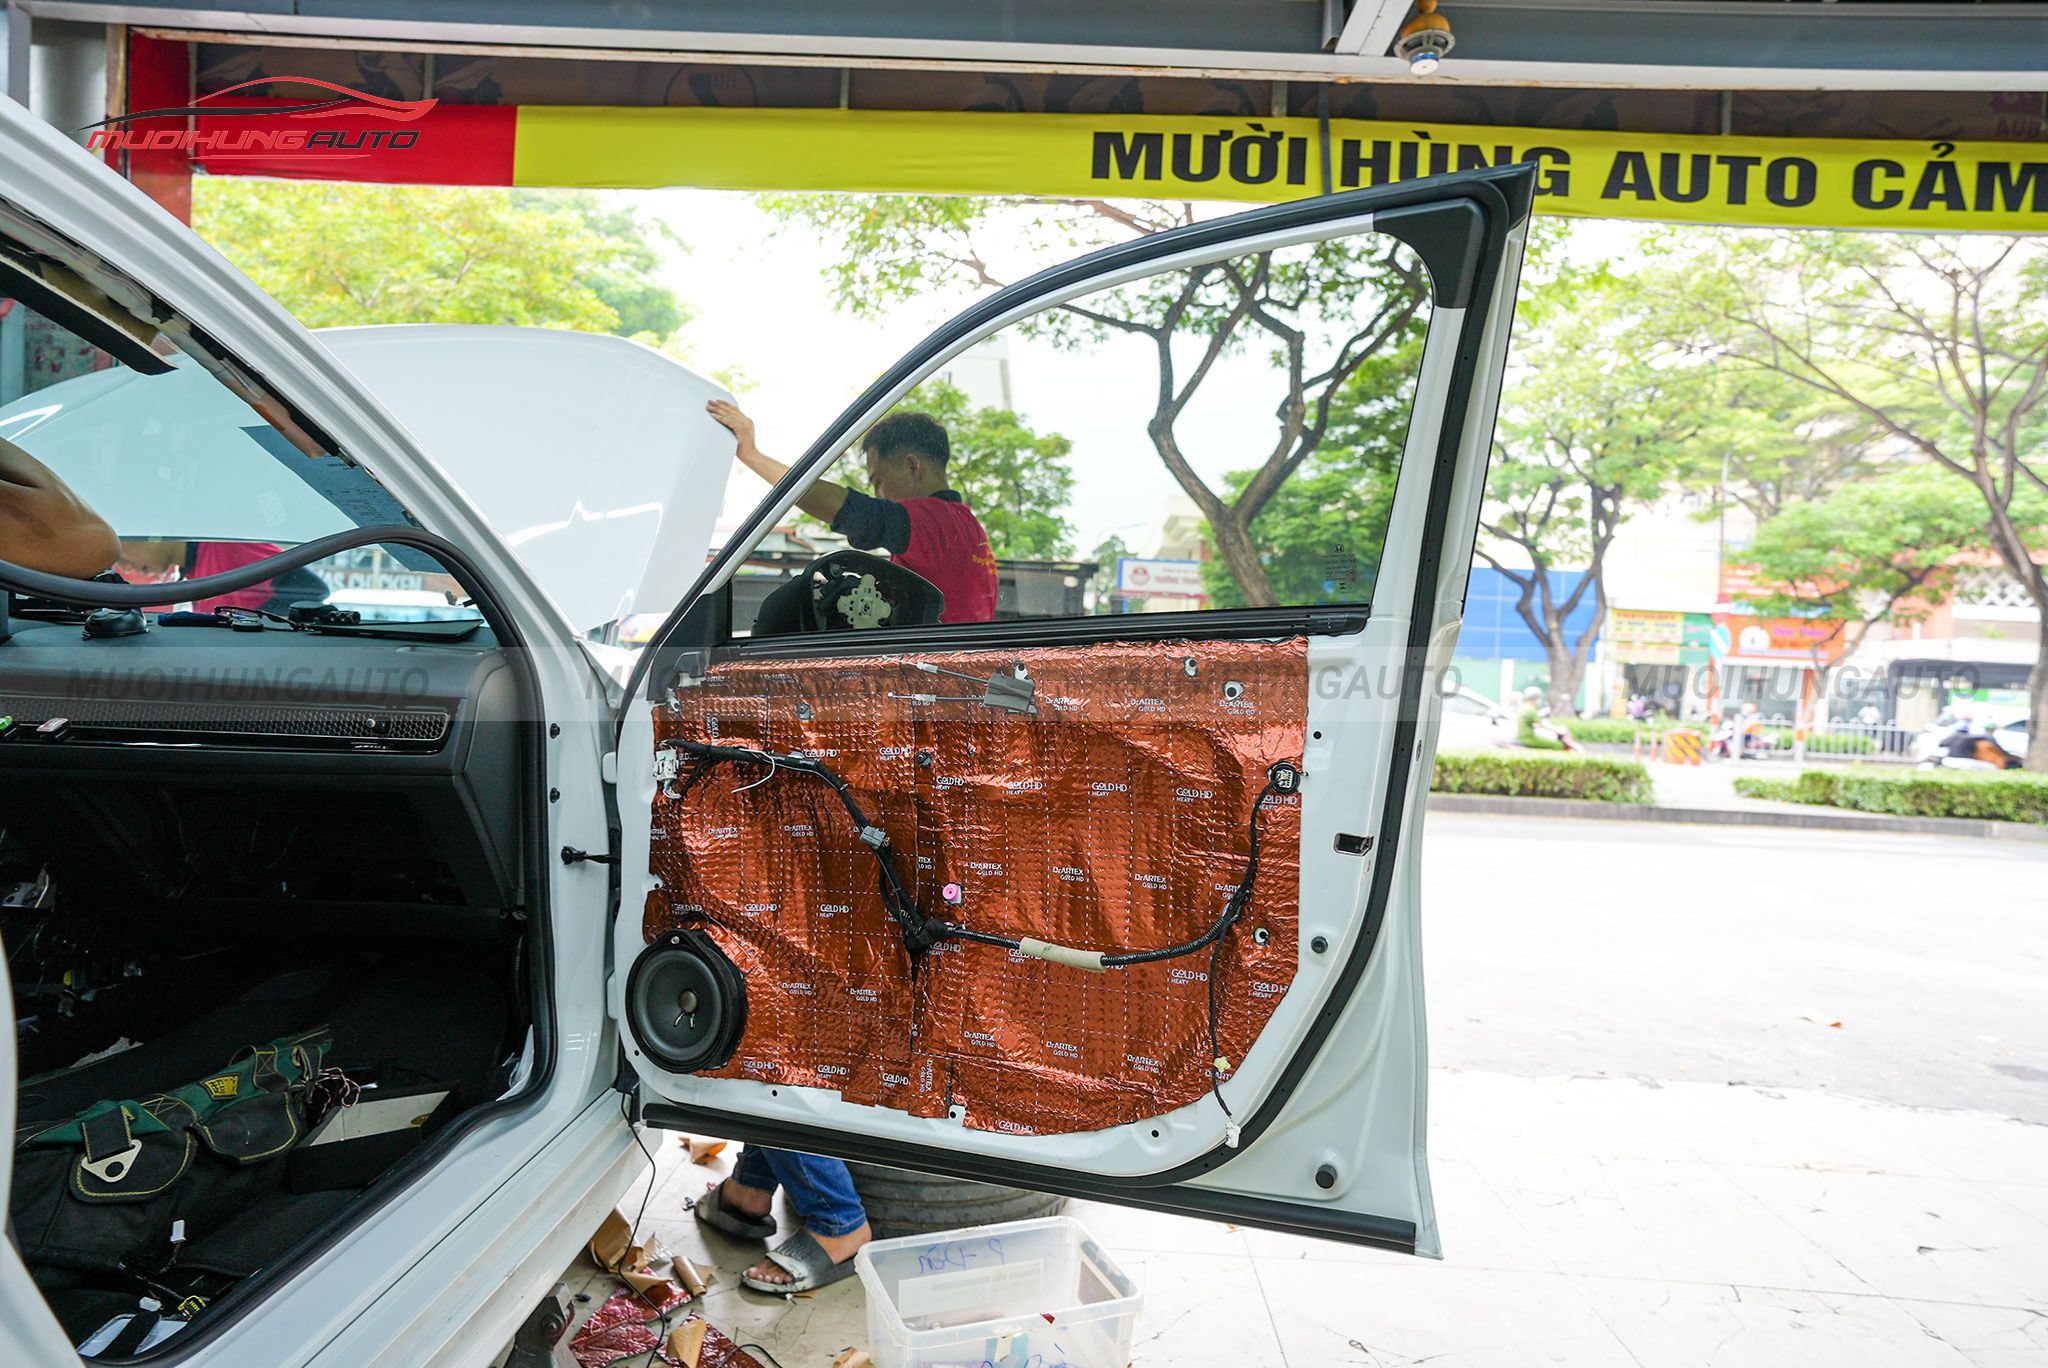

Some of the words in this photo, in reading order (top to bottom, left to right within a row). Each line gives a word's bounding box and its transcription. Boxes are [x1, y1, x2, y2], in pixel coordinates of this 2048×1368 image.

[1091, 122, 1308, 186] MƯỜI
[1600, 151, 1817, 207] AUTO
[1852, 142, 2048, 212] CẢM
[349, 574, 424, 591] CHICKEN
[879, 747, 899, 755] GOLD
[936, 776, 953, 785] GOLD
[1030, 782, 1043, 790] HD
[1091, 782, 1114, 791] GOLD
[1115, 784, 1128, 792] HD
[1176, 787, 1199, 797] GOLD
[1200, 790, 1213, 799] HD
[1283, 796, 1298, 805] HD
[970, 862, 1002, 870] DrARTEX
[1053, 867, 1083, 875] DrARTEX
[1135, 874, 1166, 883] DrARTEX
[820, 904, 838, 913] GOLD
[838, 905, 849, 914] HD
[1171, 968, 1195, 979] GOLD
[1195, 972, 1208, 982] HD
[1253, 982, 1279, 992] GOLD
[964, 1031, 995, 1041] DrARTEX
[1046, 1041, 1078, 1052] DrARTEX
[818, 1065, 836, 1074] GOLD
[837, 1067, 847, 1075] HD
[882, 1074, 899, 1084] GOLD
[899, 1077, 909, 1085] HD
[998, 1121, 1020, 1131] GOLD
[1020, 1124, 1033, 1133] HD
